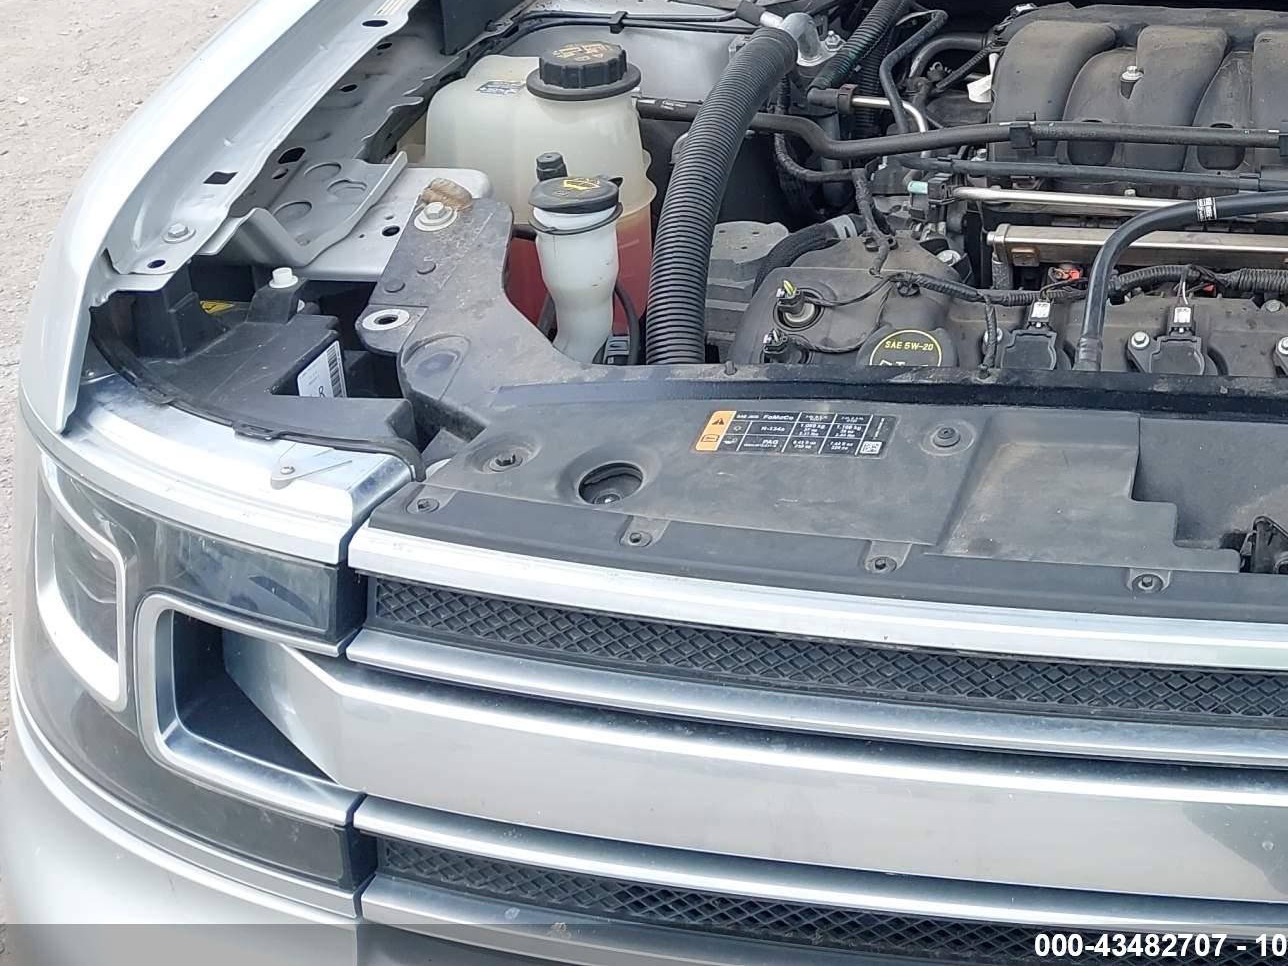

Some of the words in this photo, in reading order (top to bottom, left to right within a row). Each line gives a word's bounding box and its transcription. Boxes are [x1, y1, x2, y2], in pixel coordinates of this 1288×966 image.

[884, 340, 903, 350] SAE
[904, 341, 934, 351] 5W-20
[762, 413, 794, 421] FoMoCo
